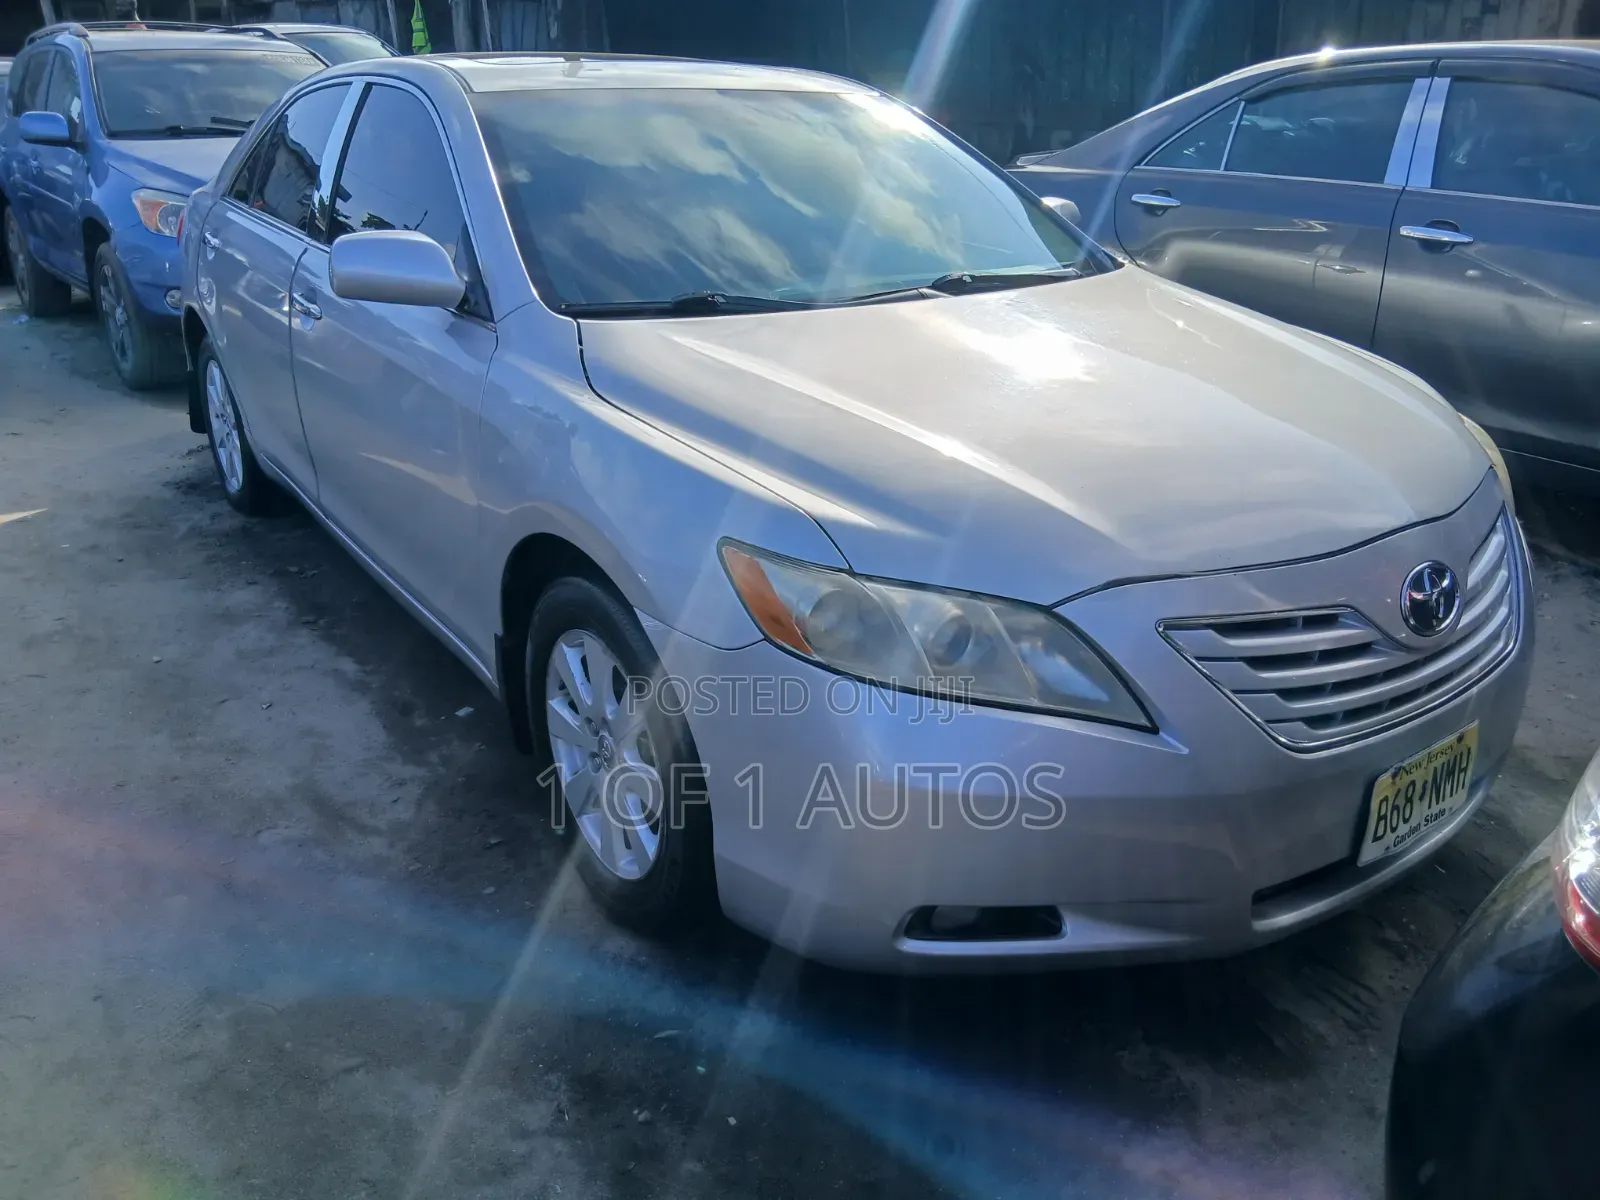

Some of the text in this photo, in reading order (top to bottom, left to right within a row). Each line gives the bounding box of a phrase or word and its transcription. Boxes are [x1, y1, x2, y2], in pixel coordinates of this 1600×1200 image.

[1399, 742, 1456, 781] New Jersey
[1393, 807, 1446, 848] Garden State
